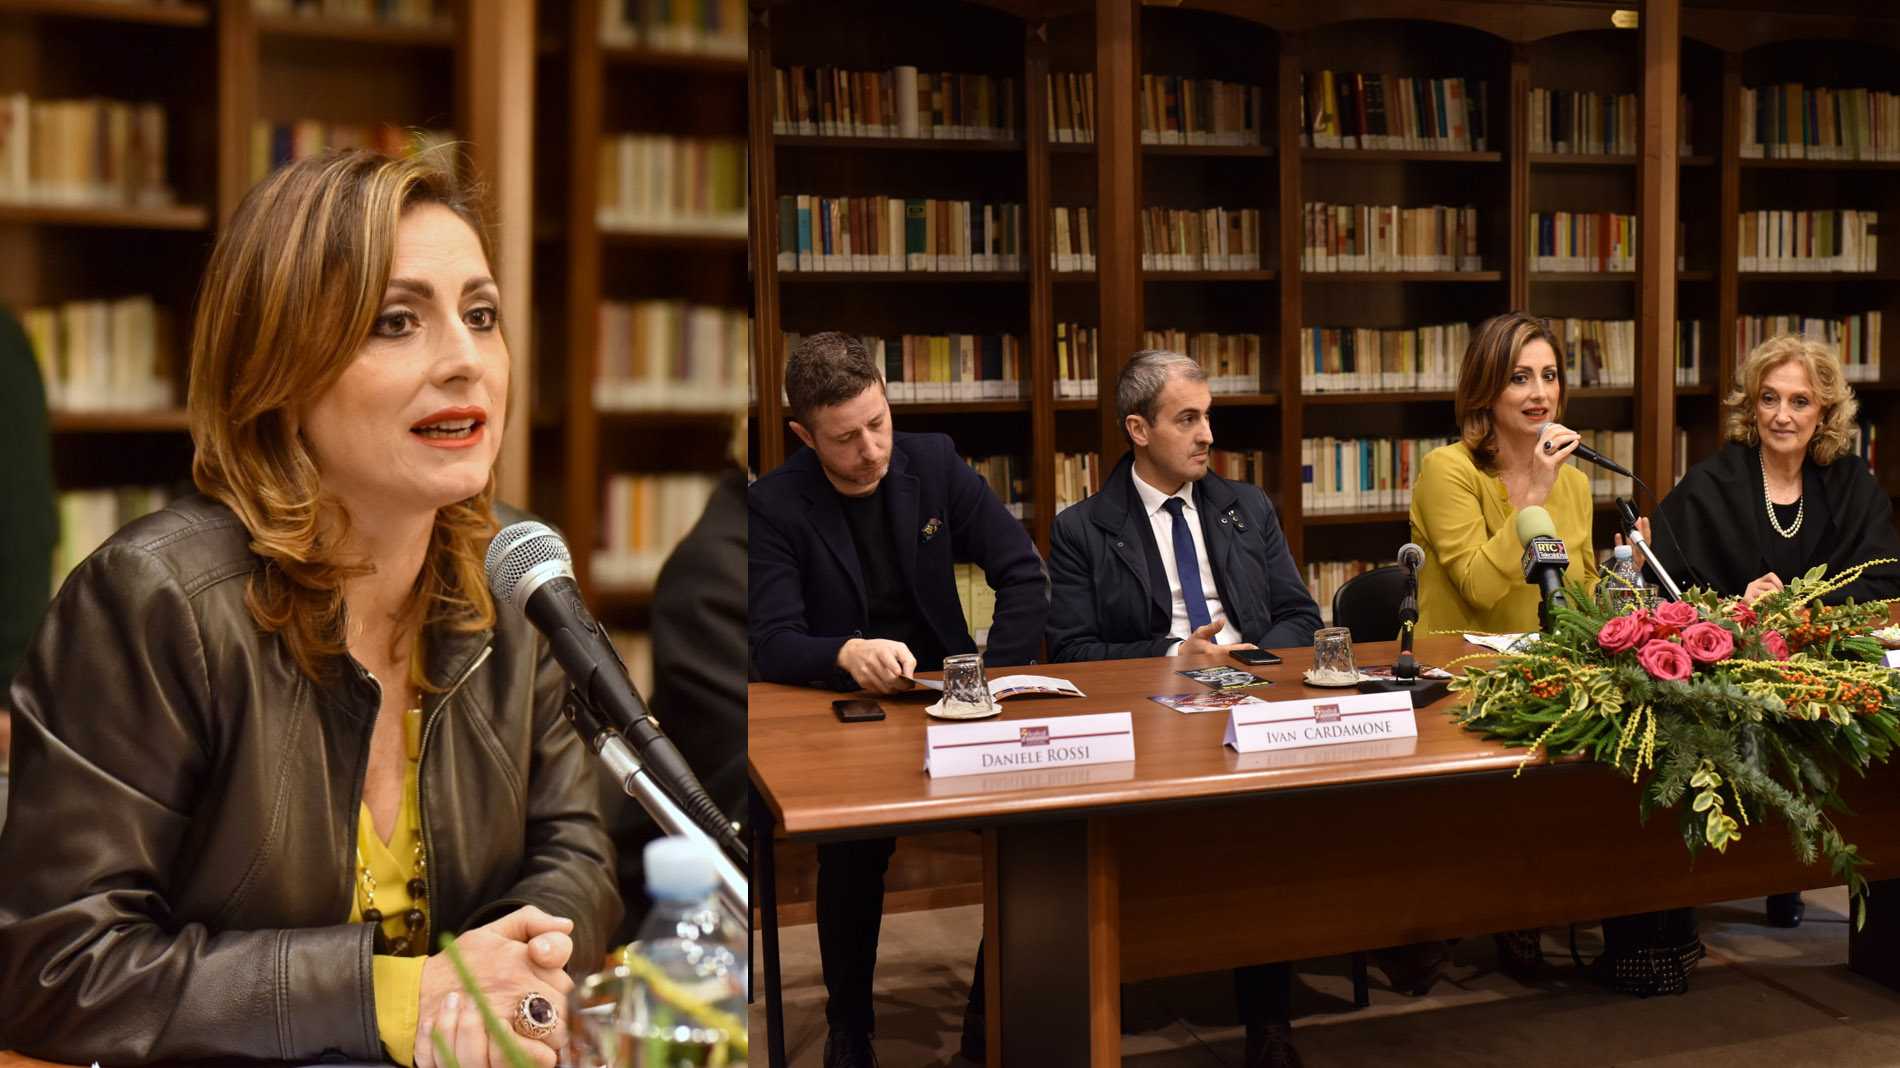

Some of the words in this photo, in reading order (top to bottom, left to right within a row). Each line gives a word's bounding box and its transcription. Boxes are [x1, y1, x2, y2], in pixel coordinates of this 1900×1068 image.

[1538, 543, 1558, 552] RTC
[1266, 731, 1297, 744] IVAN
[1303, 721, 1392, 740] CARDAMONE
[981, 751, 1041, 767] DANIELE
[1047, 746, 1090, 762] ROSSI
